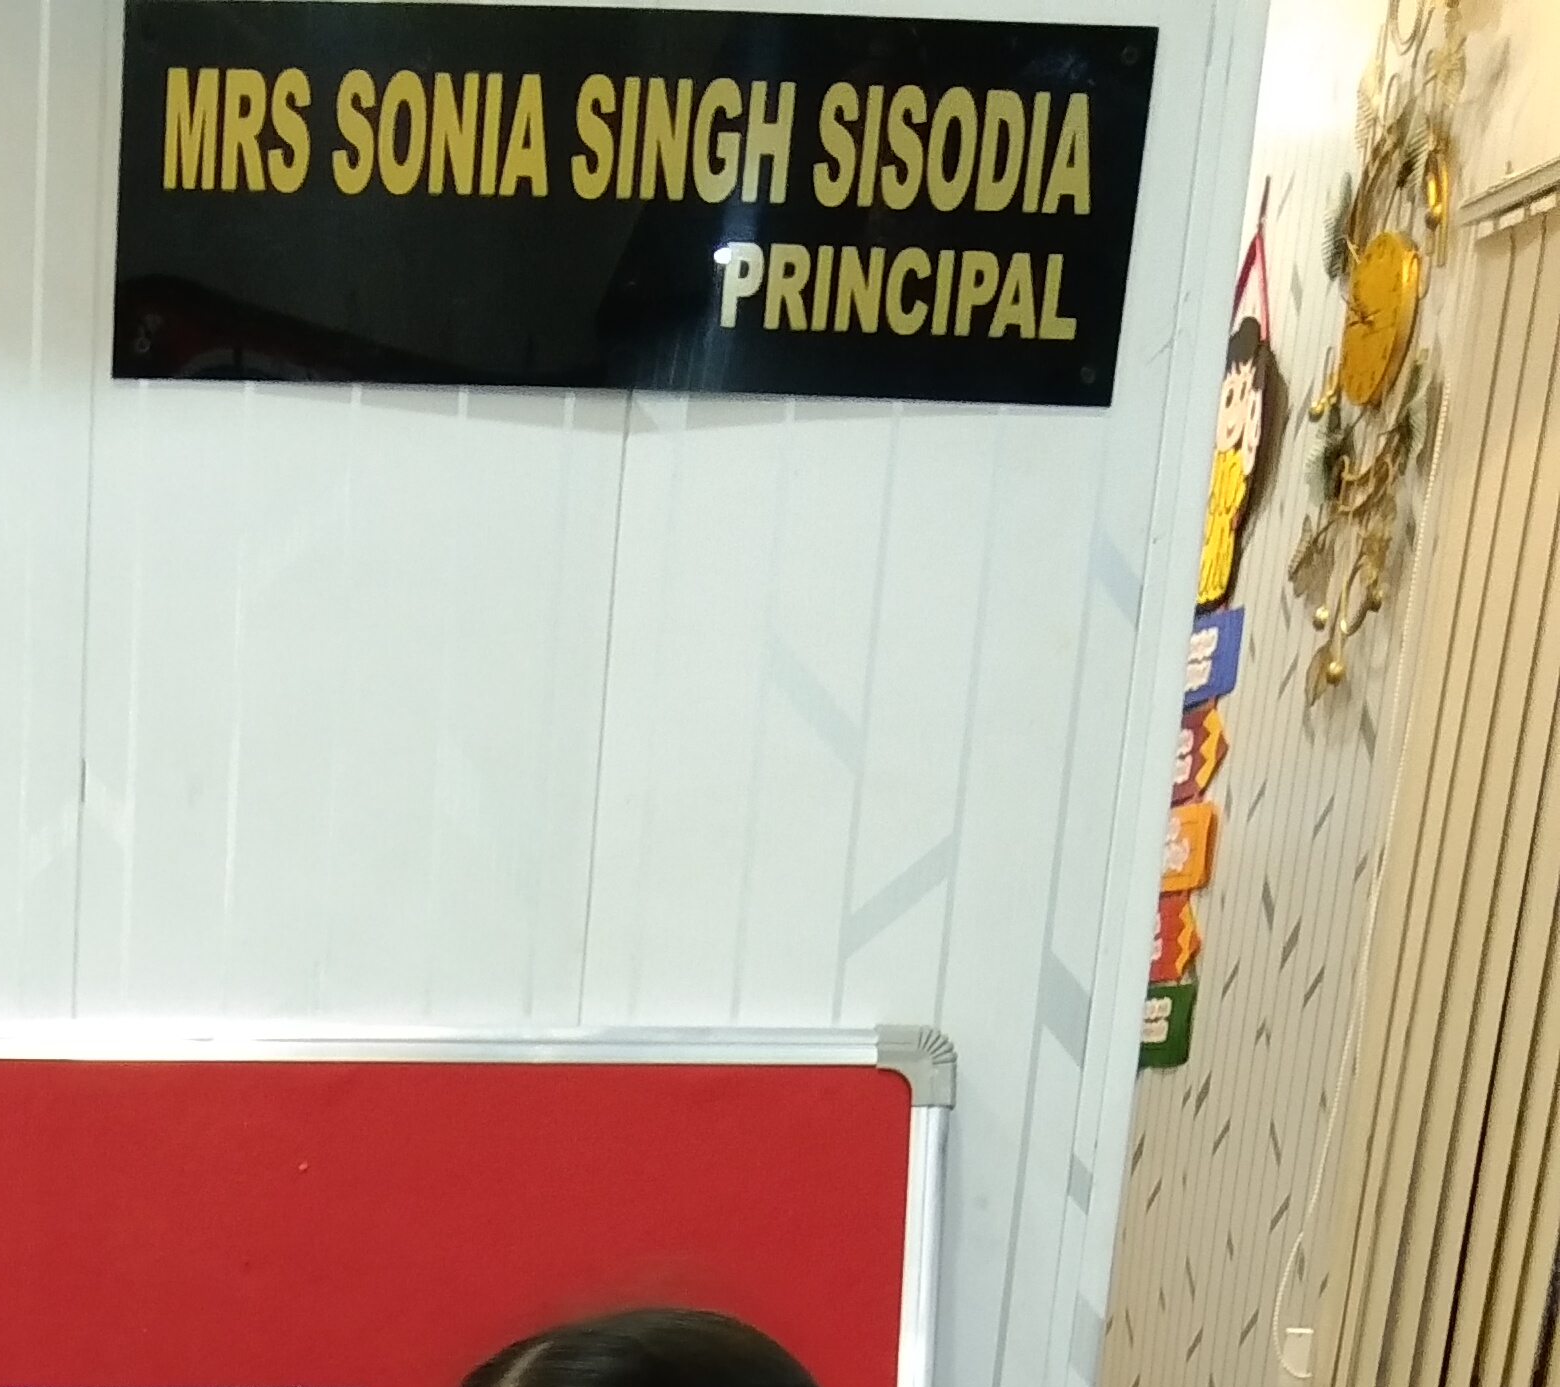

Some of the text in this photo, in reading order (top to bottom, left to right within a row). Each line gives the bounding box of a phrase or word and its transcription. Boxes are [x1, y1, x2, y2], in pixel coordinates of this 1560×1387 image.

[163, 67, 1091, 215] MRS SONIA SINGH SISODIA
[719, 242, 1077, 341] PRINCIPAL
